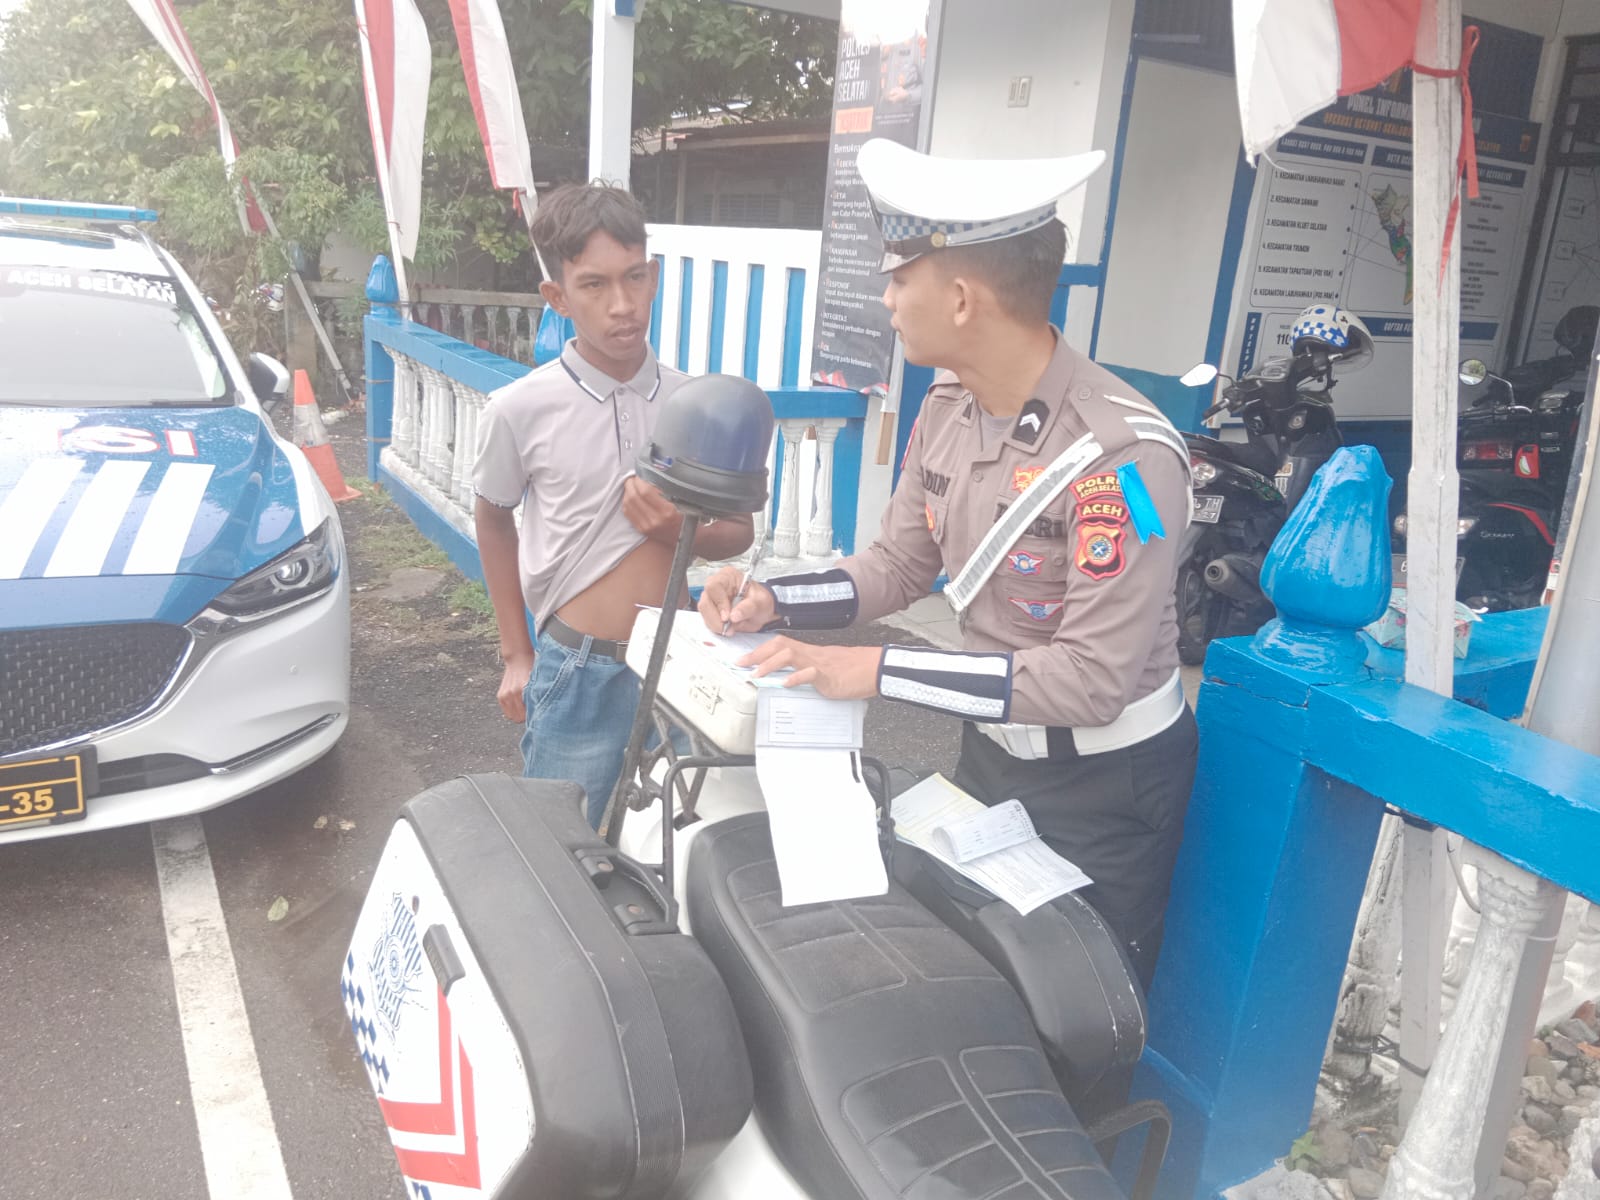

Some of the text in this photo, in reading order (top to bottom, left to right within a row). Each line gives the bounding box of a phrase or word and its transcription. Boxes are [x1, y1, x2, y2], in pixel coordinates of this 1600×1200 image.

[840, 59, 860, 80] ACEH
[837, 80, 871, 102] SELATAN
[8, 270, 177, 304] ACEH SELATAN
[1082, 503, 1123, 517] ACEH
